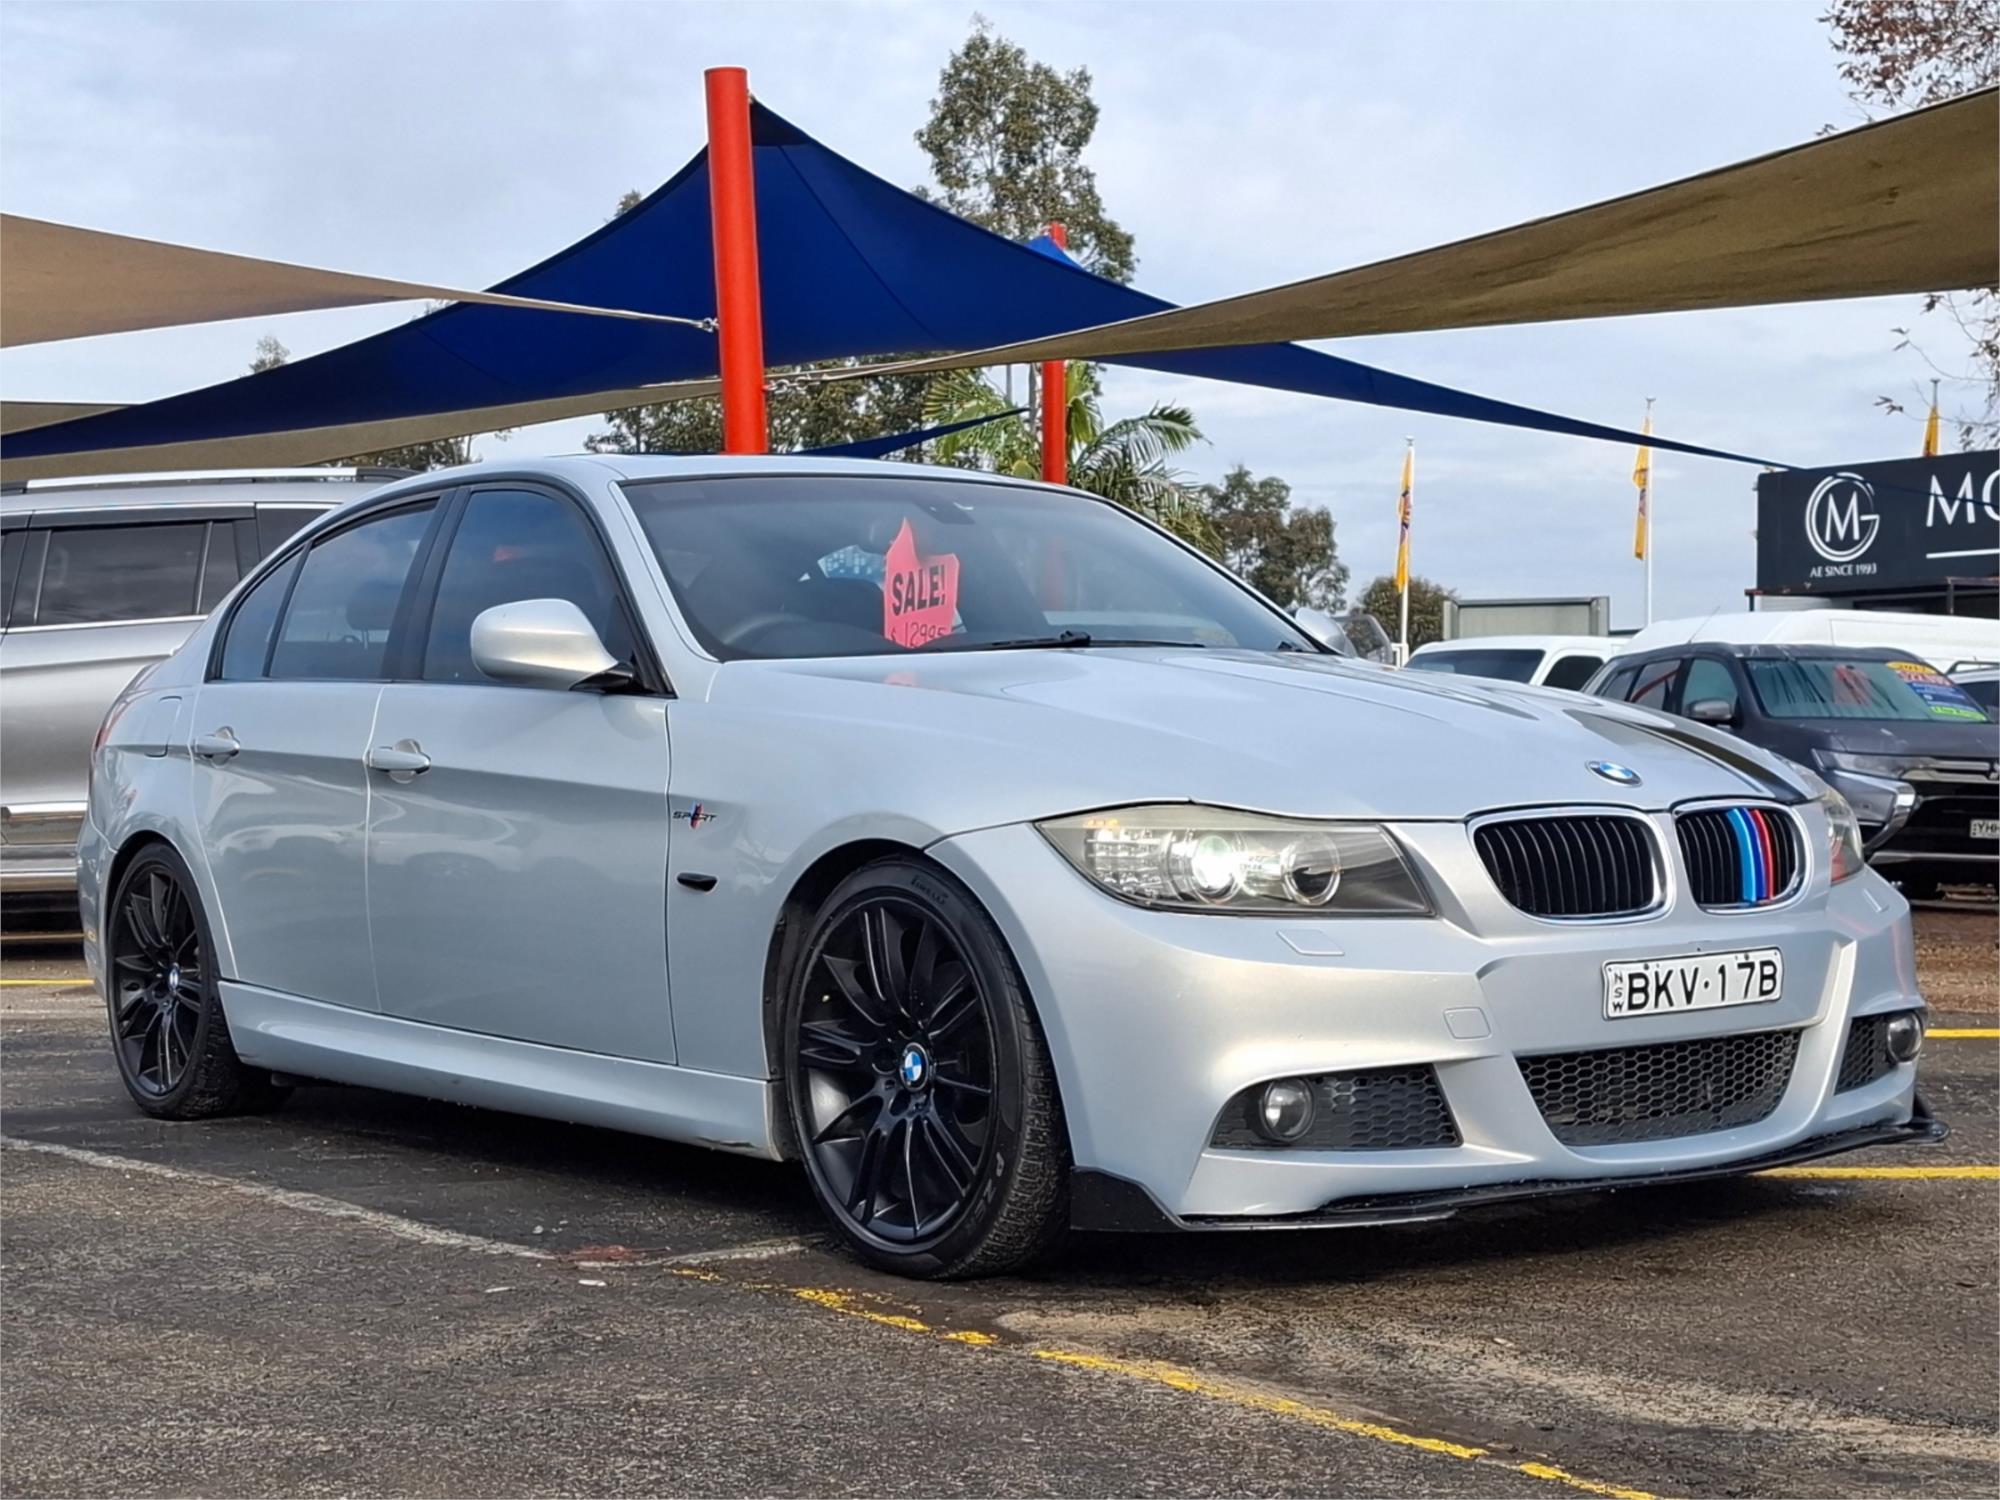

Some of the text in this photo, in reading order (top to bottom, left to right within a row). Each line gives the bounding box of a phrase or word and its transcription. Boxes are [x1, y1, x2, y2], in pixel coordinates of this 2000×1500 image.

[892, 564, 945, 616] SALE!
[1825, 564, 1853, 577] SINCE
[1612, 972, 1624, 1012] NSW
